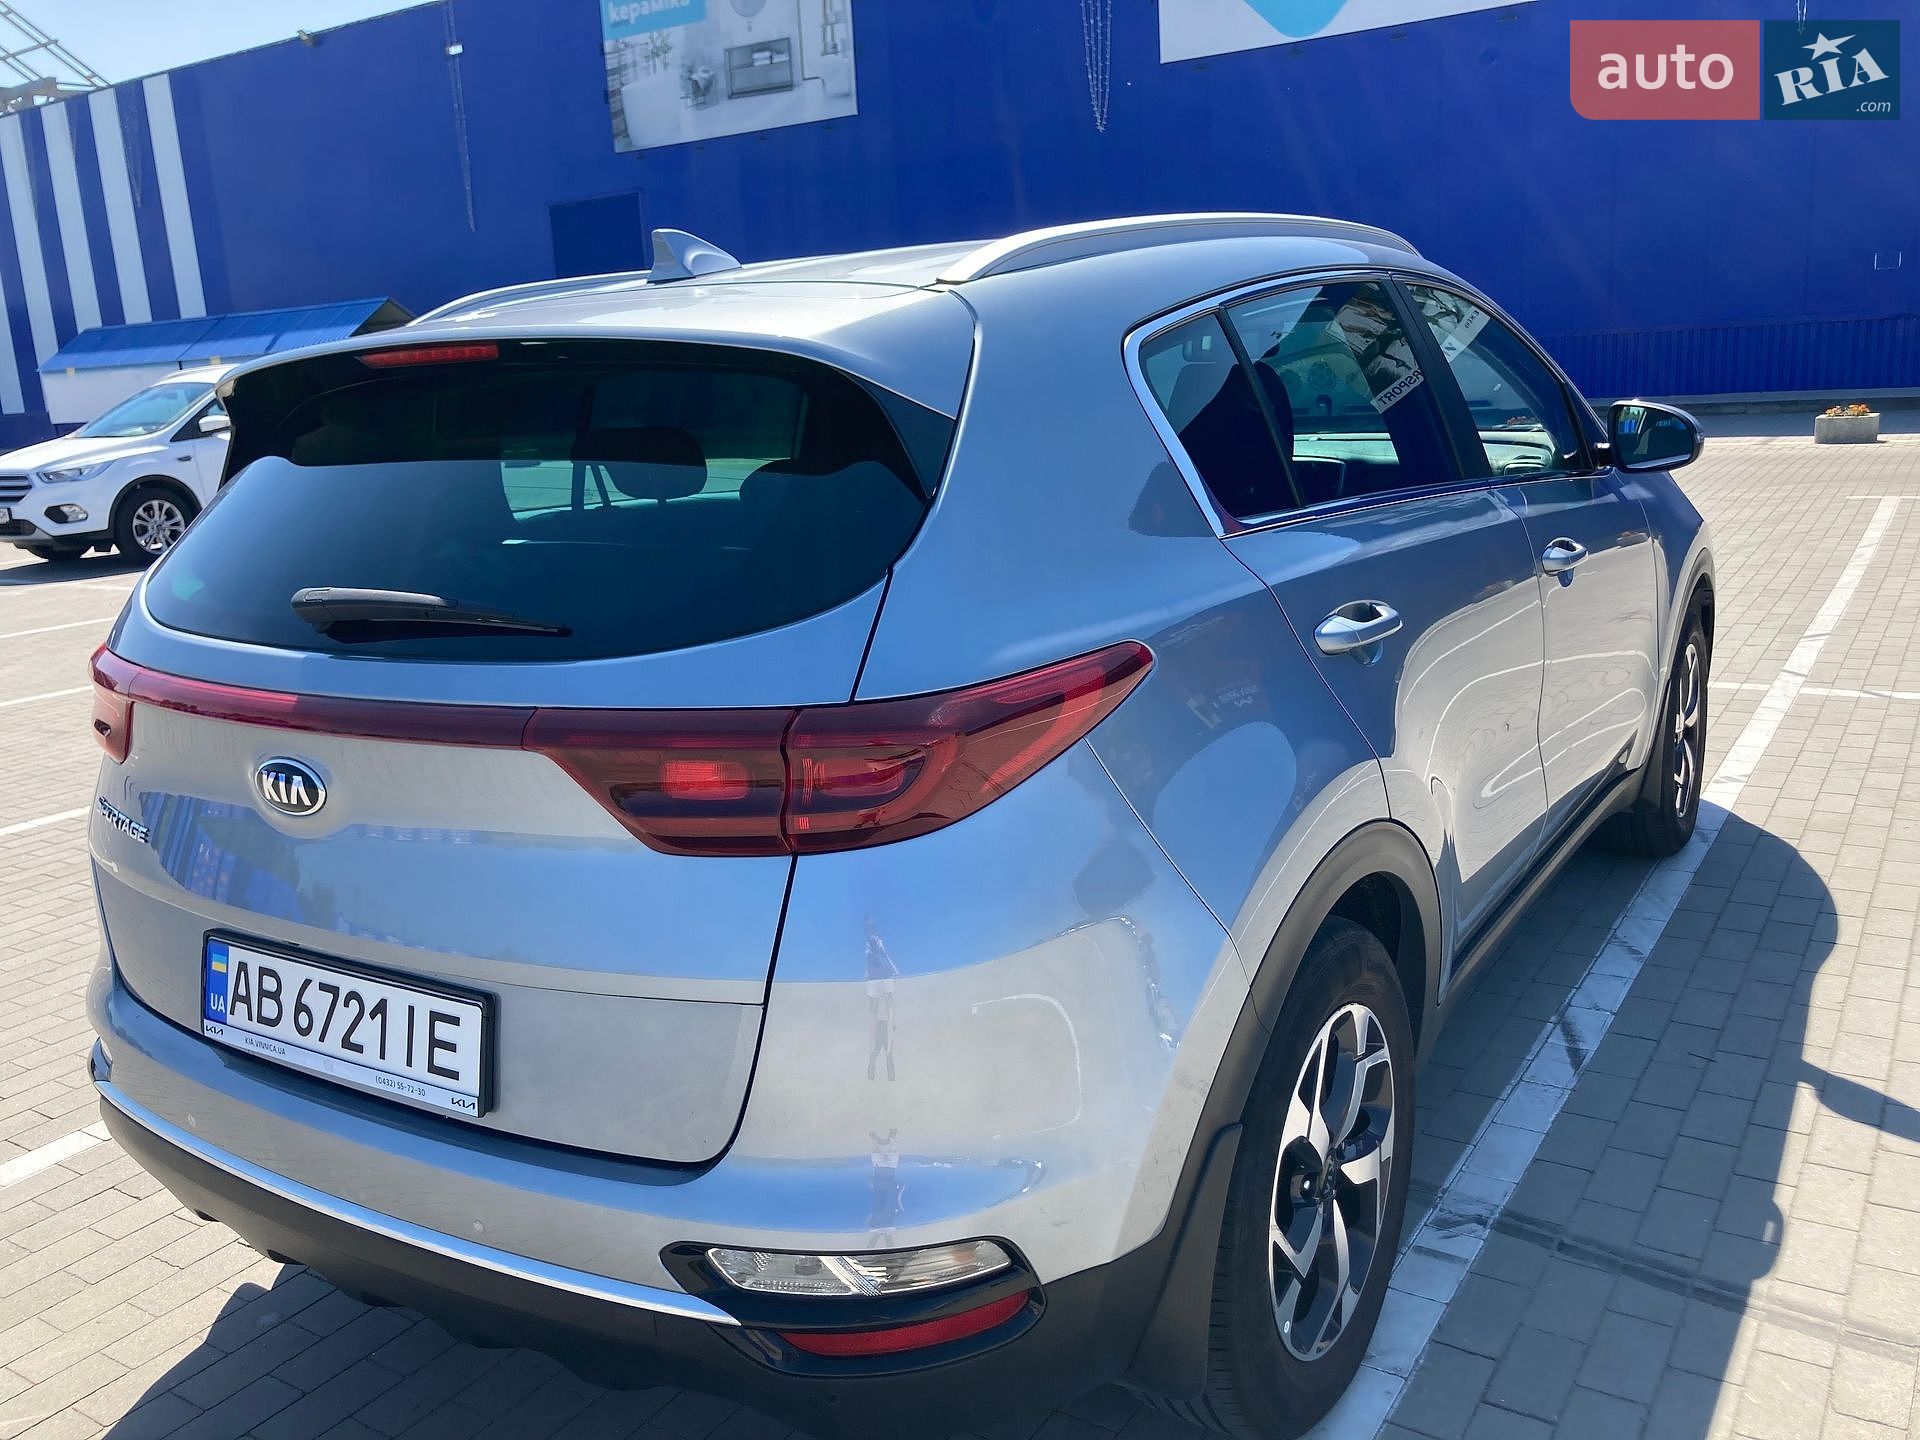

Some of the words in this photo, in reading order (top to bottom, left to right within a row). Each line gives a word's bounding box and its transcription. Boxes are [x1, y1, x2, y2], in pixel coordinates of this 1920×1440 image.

[262, 770, 312, 806] KIA
[210, 993, 225, 1013] UA
[229, 961, 283, 1028] AB
[293, 978, 389, 1061] 6721
[406, 1004, 461, 1081] IE
